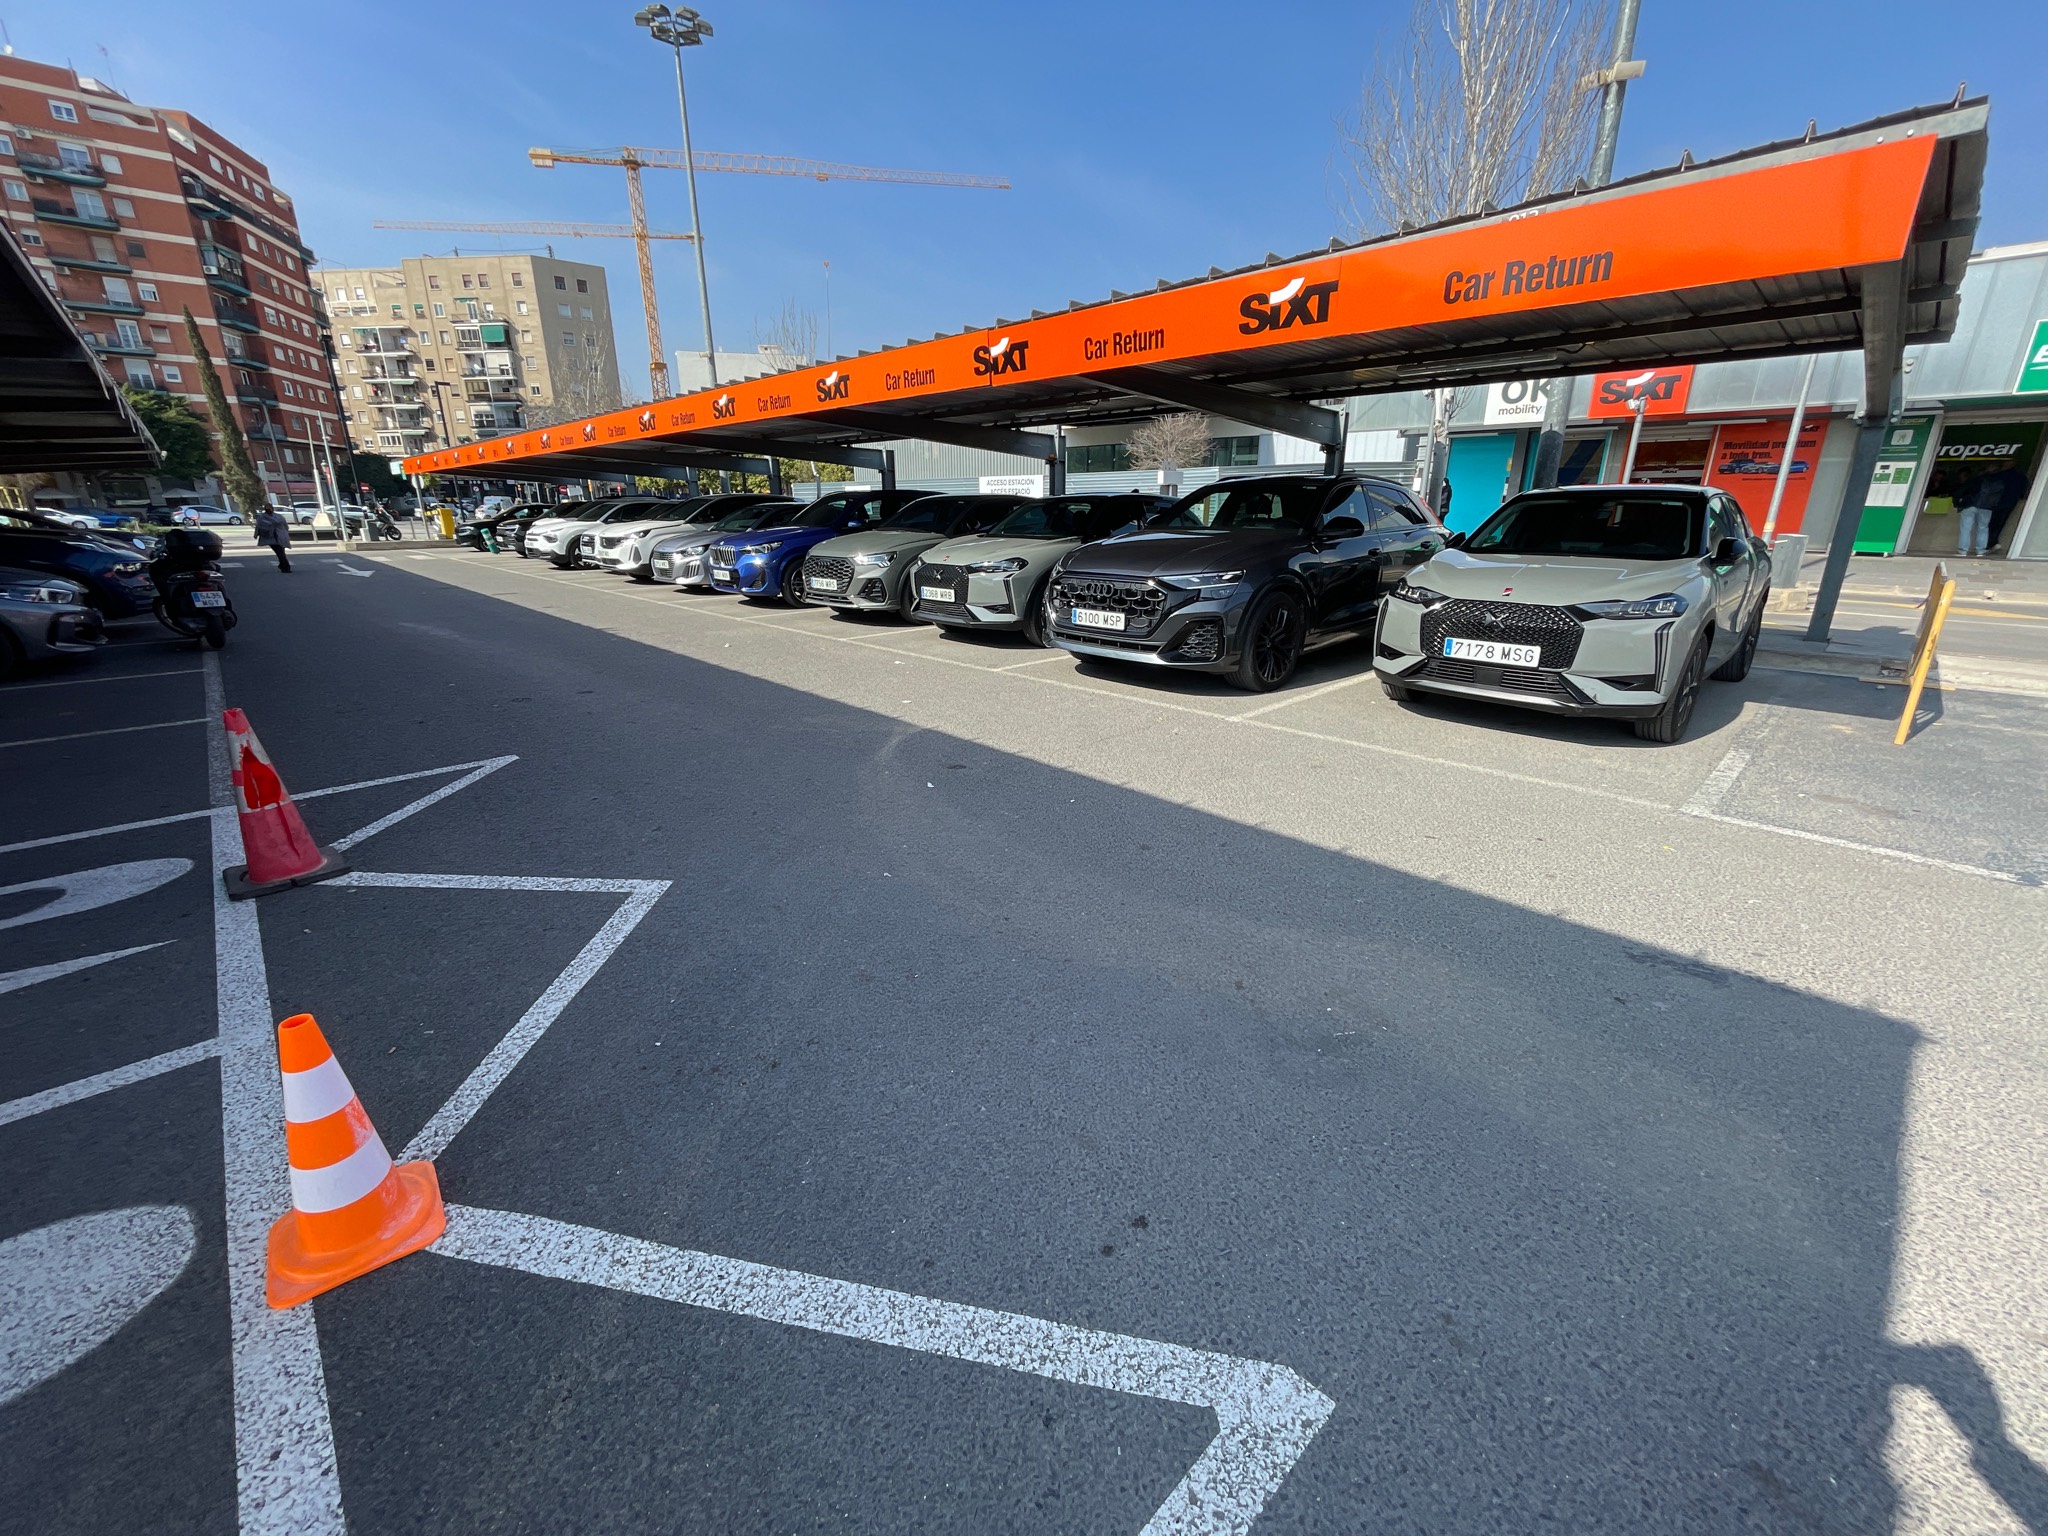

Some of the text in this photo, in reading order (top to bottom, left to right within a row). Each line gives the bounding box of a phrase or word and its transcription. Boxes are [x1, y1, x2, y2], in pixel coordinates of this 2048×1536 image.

[1443, 250, 1614, 305] Car Return
[1238, 276, 1340, 336] SIXT
[973, 336, 1029, 377] SIXT
[1083, 327, 1165, 362] Car Return
[816, 370, 850, 402] SIXT
[885, 367, 936, 391] Car Return
[1599, 371, 1683, 405] SIXT
[712, 393, 736, 420] SIXT
[757, 394, 791, 412] Car Return
[1498, 403, 1543, 416] mobility
[638, 410, 656, 432] SIXT
[671, 412, 696, 427] Car Return
[986, 479, 1007, 487] ACCESO
[1077, 611, 1121, 627] 6100 MSP
[1454, 641, 1534, 663] 7178 MSG
